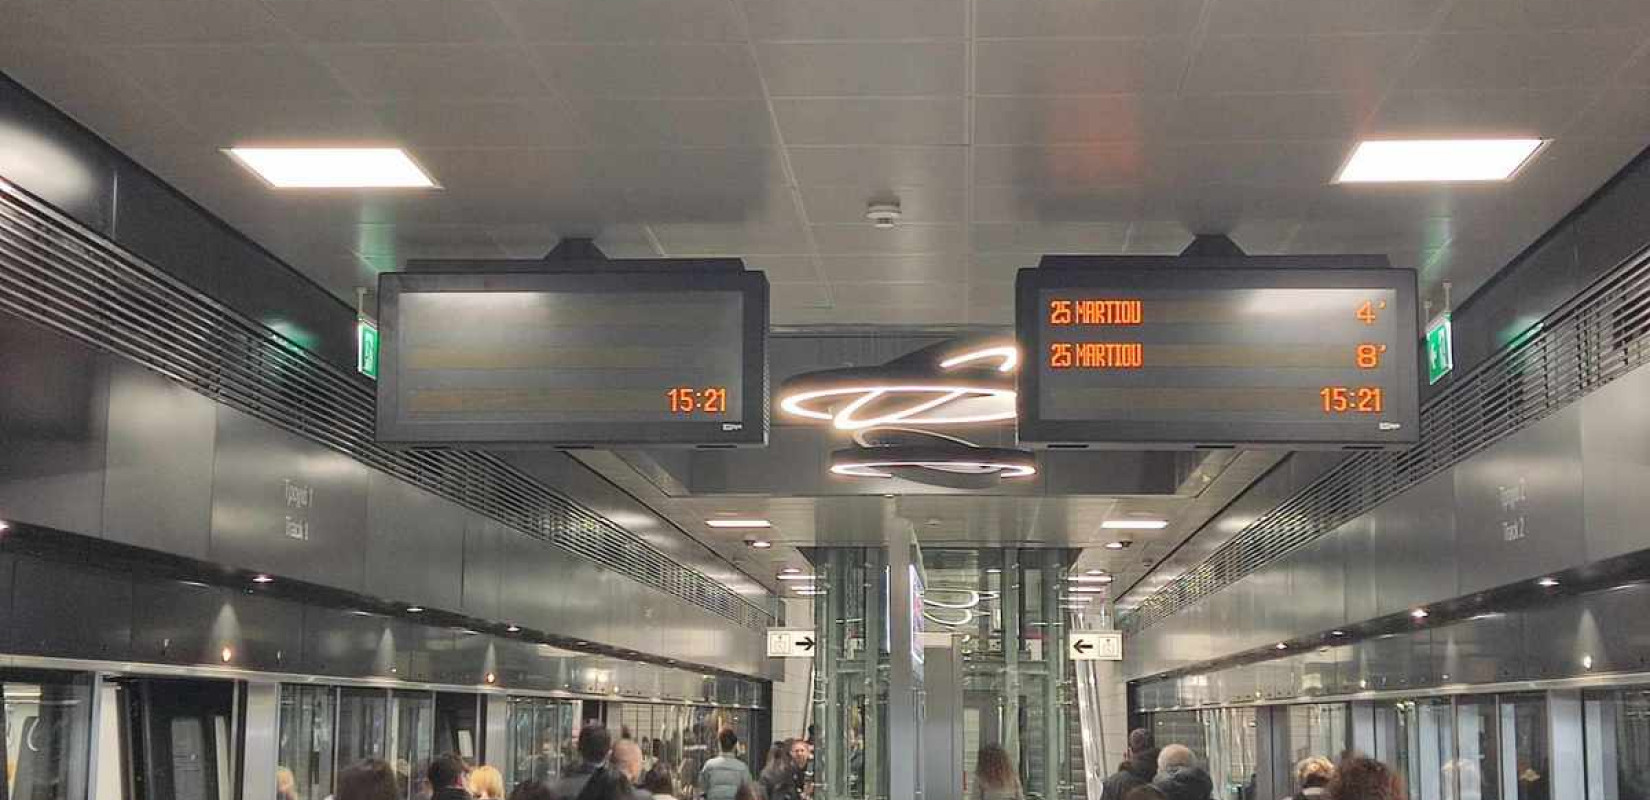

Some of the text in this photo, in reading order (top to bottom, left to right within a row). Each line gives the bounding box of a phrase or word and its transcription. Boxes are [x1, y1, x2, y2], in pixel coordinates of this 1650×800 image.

[1051, 300, 1072, 324] 25
[1075, 300, 1142, 324] MARTIOU
[1051, 343, 1072, 367] 25
[1075, 343, 1142, 367] MARTIOU
[666, 387, 728, 412] 15:21
[1319, 387, 1382, 412] 15:21
